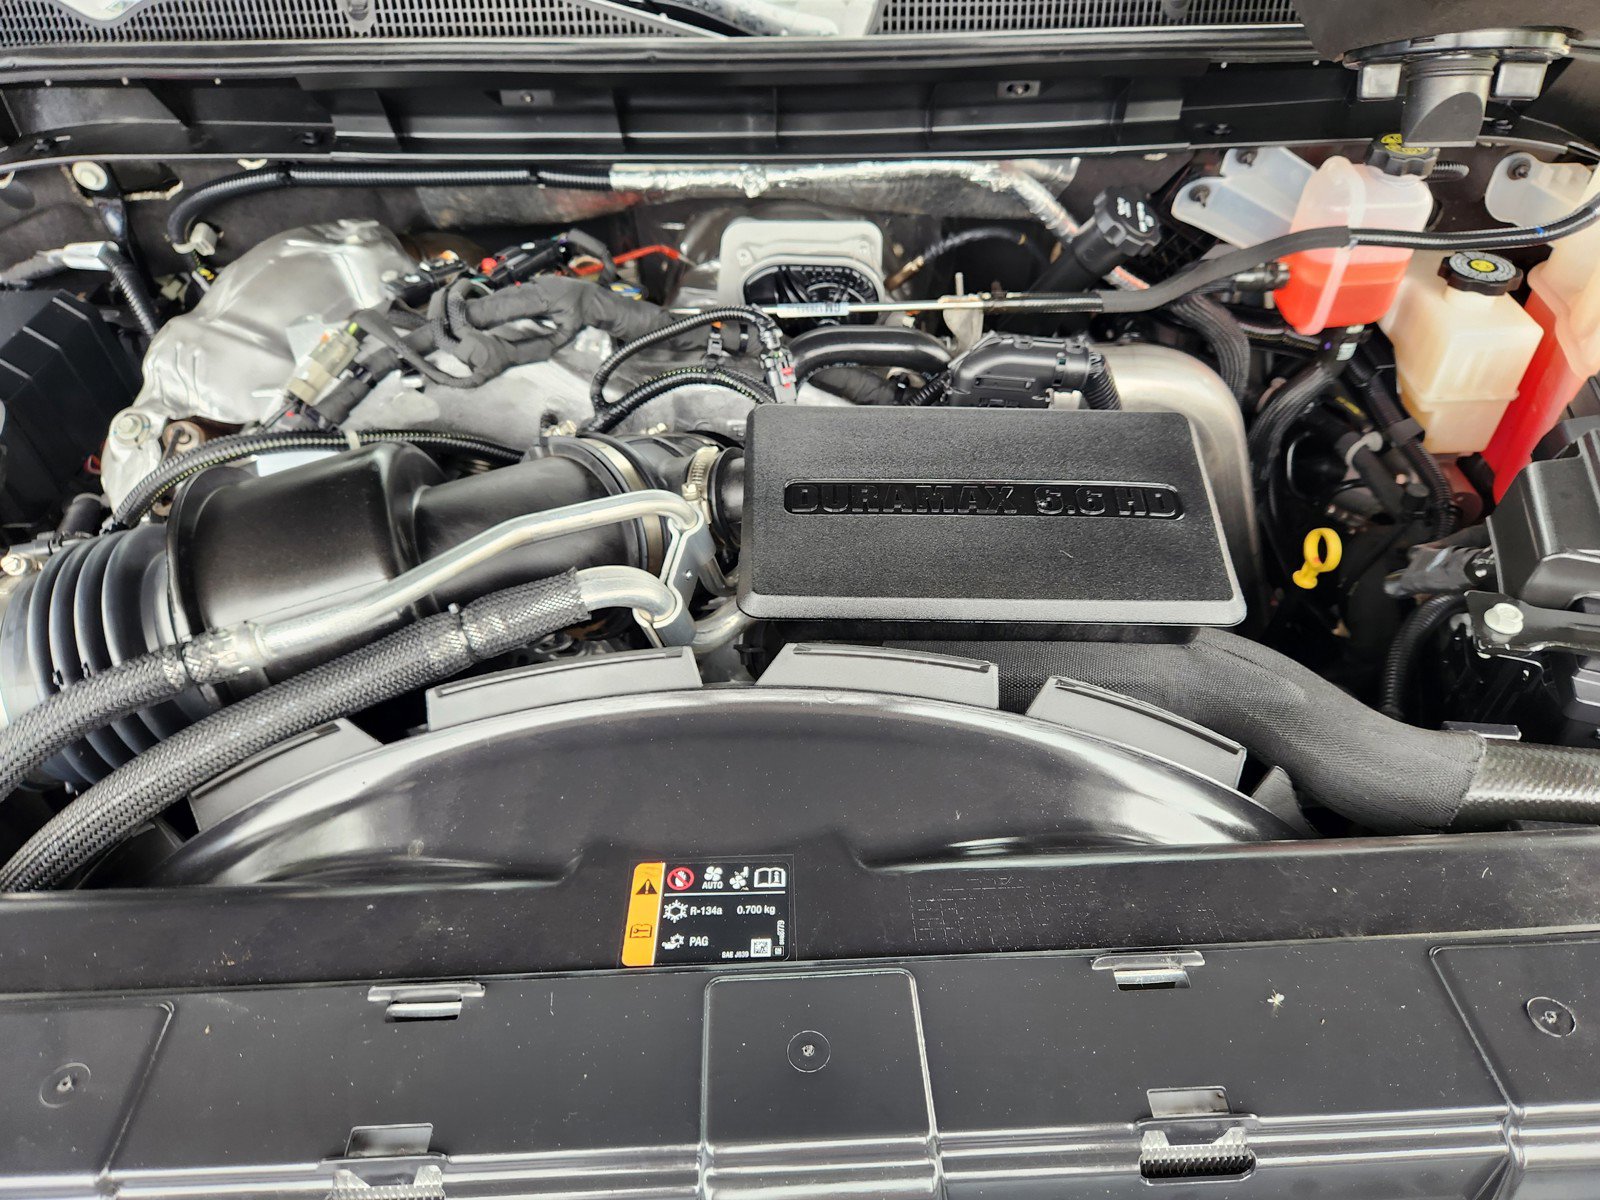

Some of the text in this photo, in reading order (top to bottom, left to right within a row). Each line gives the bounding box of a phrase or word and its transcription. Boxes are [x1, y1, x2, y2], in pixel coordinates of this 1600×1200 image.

[790, 484, 1018, 514] DURAMAX
[1114, 487, 1177, 518] HD
[701, 881, 724, 890] AUTO
[689, 904, 776, 916] R-134a 0.700 kg
[689, 935, 709, 947] PAG
